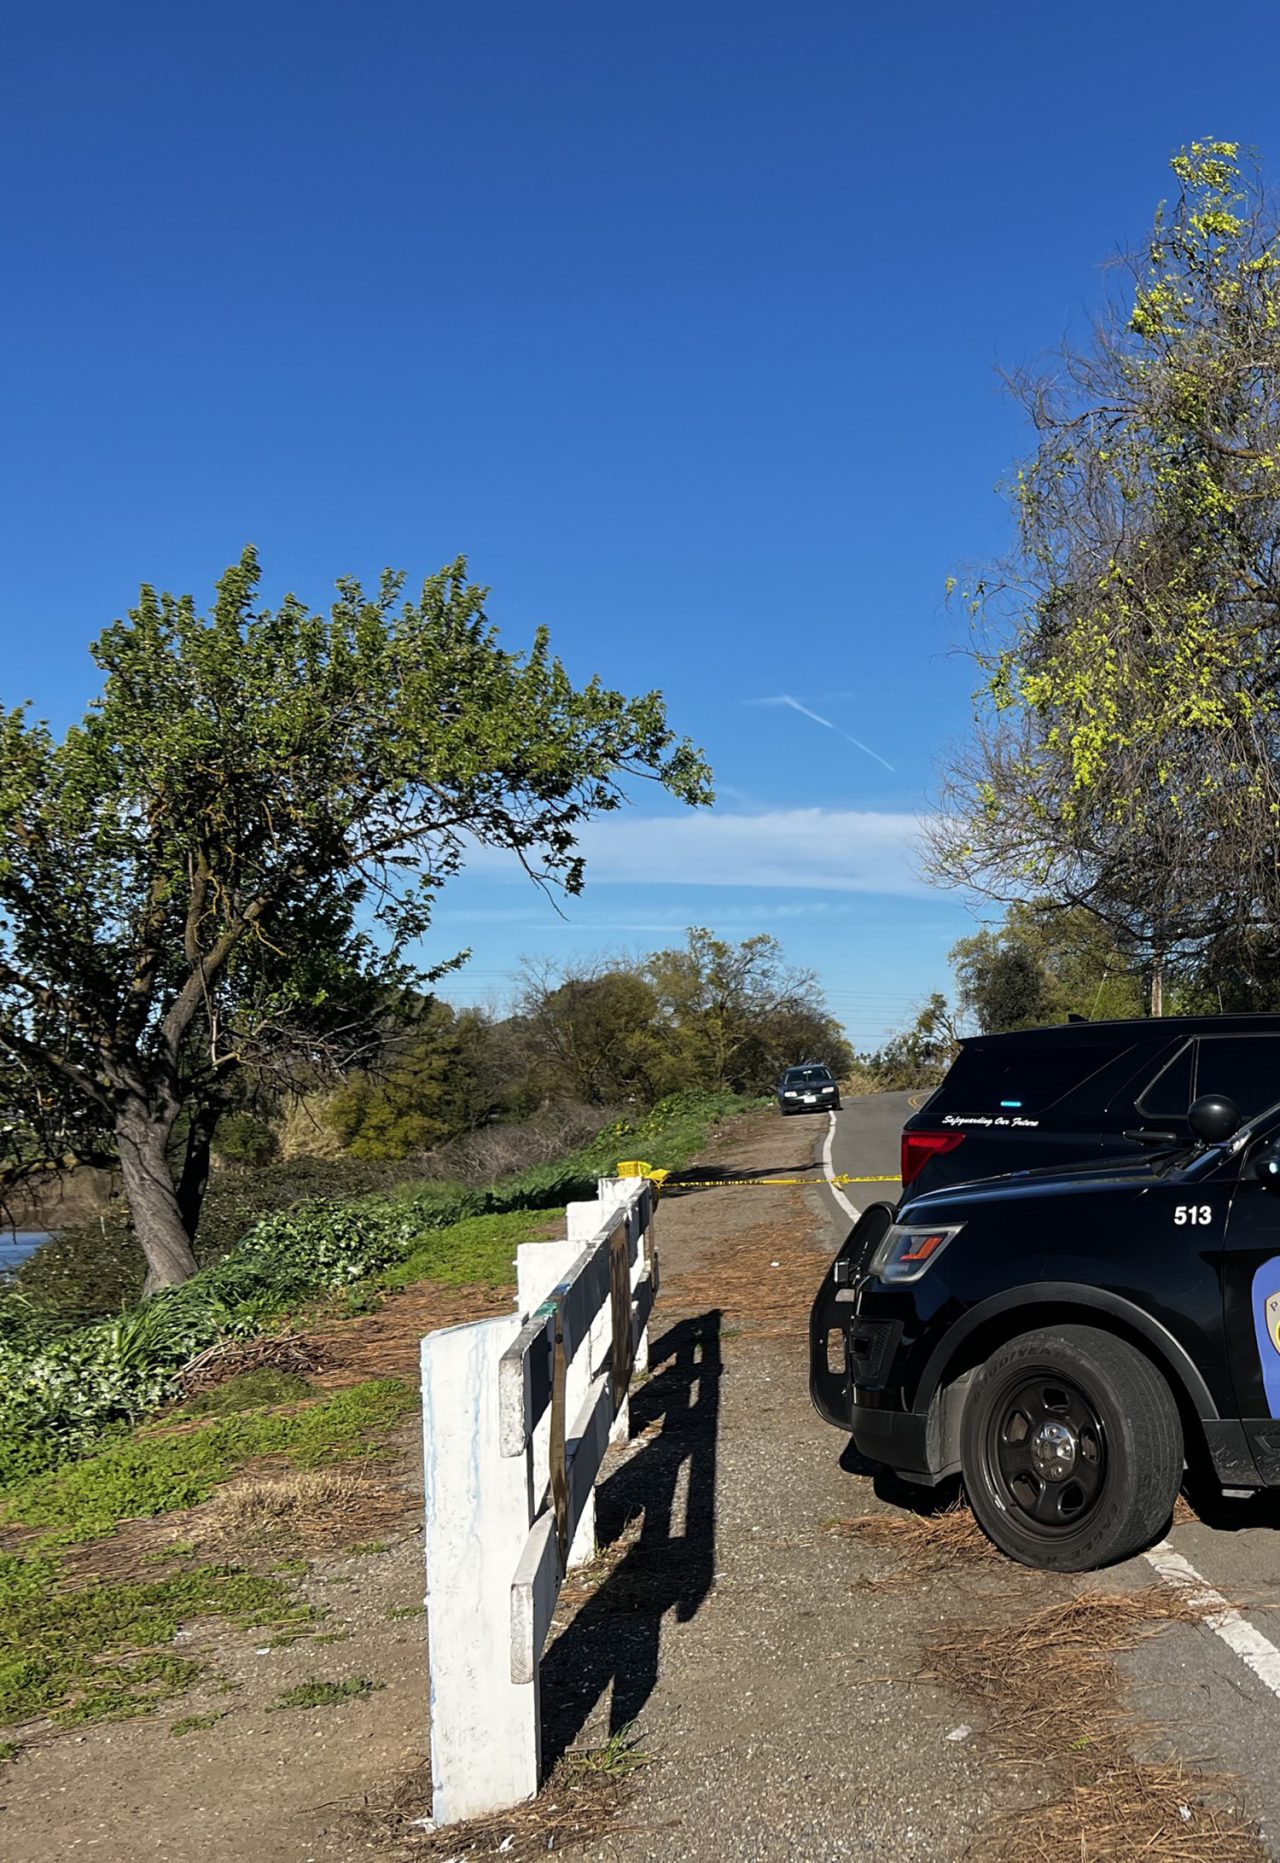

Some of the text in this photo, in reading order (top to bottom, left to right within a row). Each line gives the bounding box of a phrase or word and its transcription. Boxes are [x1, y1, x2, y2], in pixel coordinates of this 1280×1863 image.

[941, 1115, 1039, 1127] Safeguarding Our Future
[1173, 1205, 1212, 1225] 513
